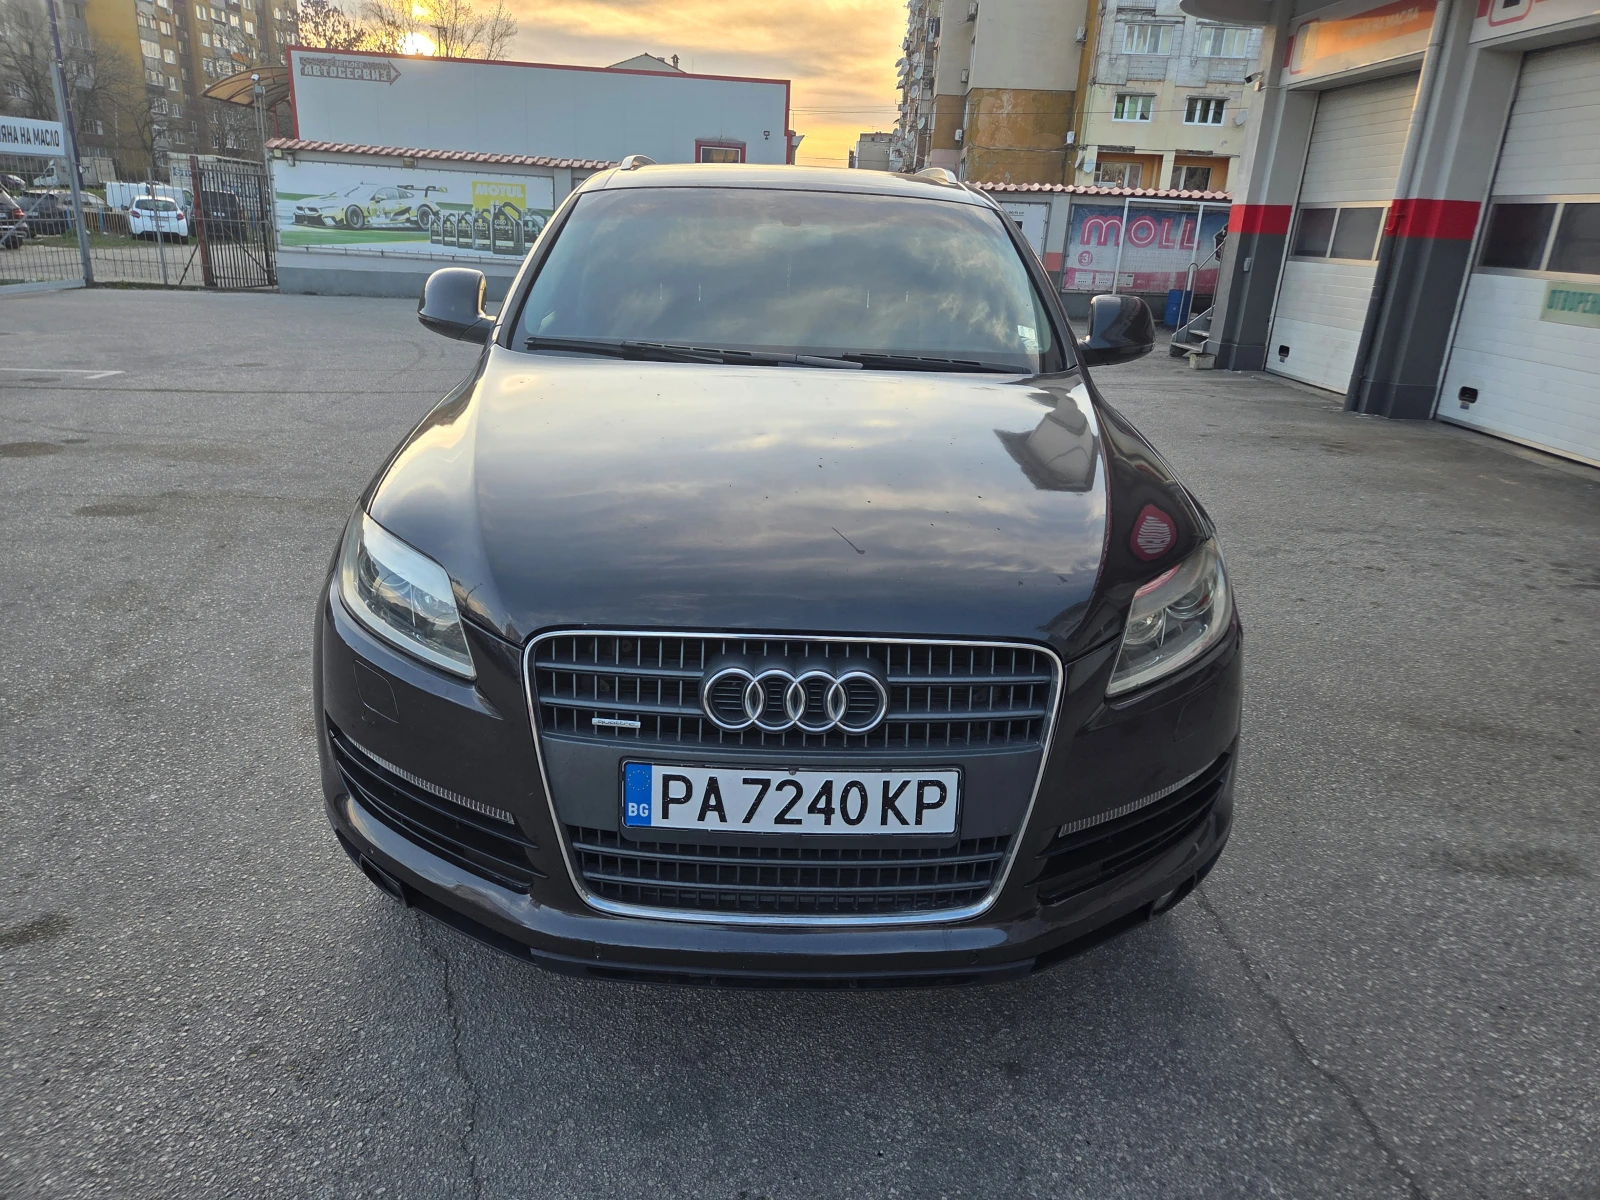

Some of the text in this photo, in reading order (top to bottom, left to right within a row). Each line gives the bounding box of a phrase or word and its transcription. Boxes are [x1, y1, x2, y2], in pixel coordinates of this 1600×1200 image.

[304, 64, 388, 80] АВТОСЕРВИЗ
[0, 125, 60, 147] ЯНА НА МАСЛО
[476, 183, 524, 198] MOTUL
[1080, 214, 1201, 250] MOLL
[597, 719, 636, 727] quattro
[627, 802, 649, 817] BG
[741, 777, 869, 826] 7240
